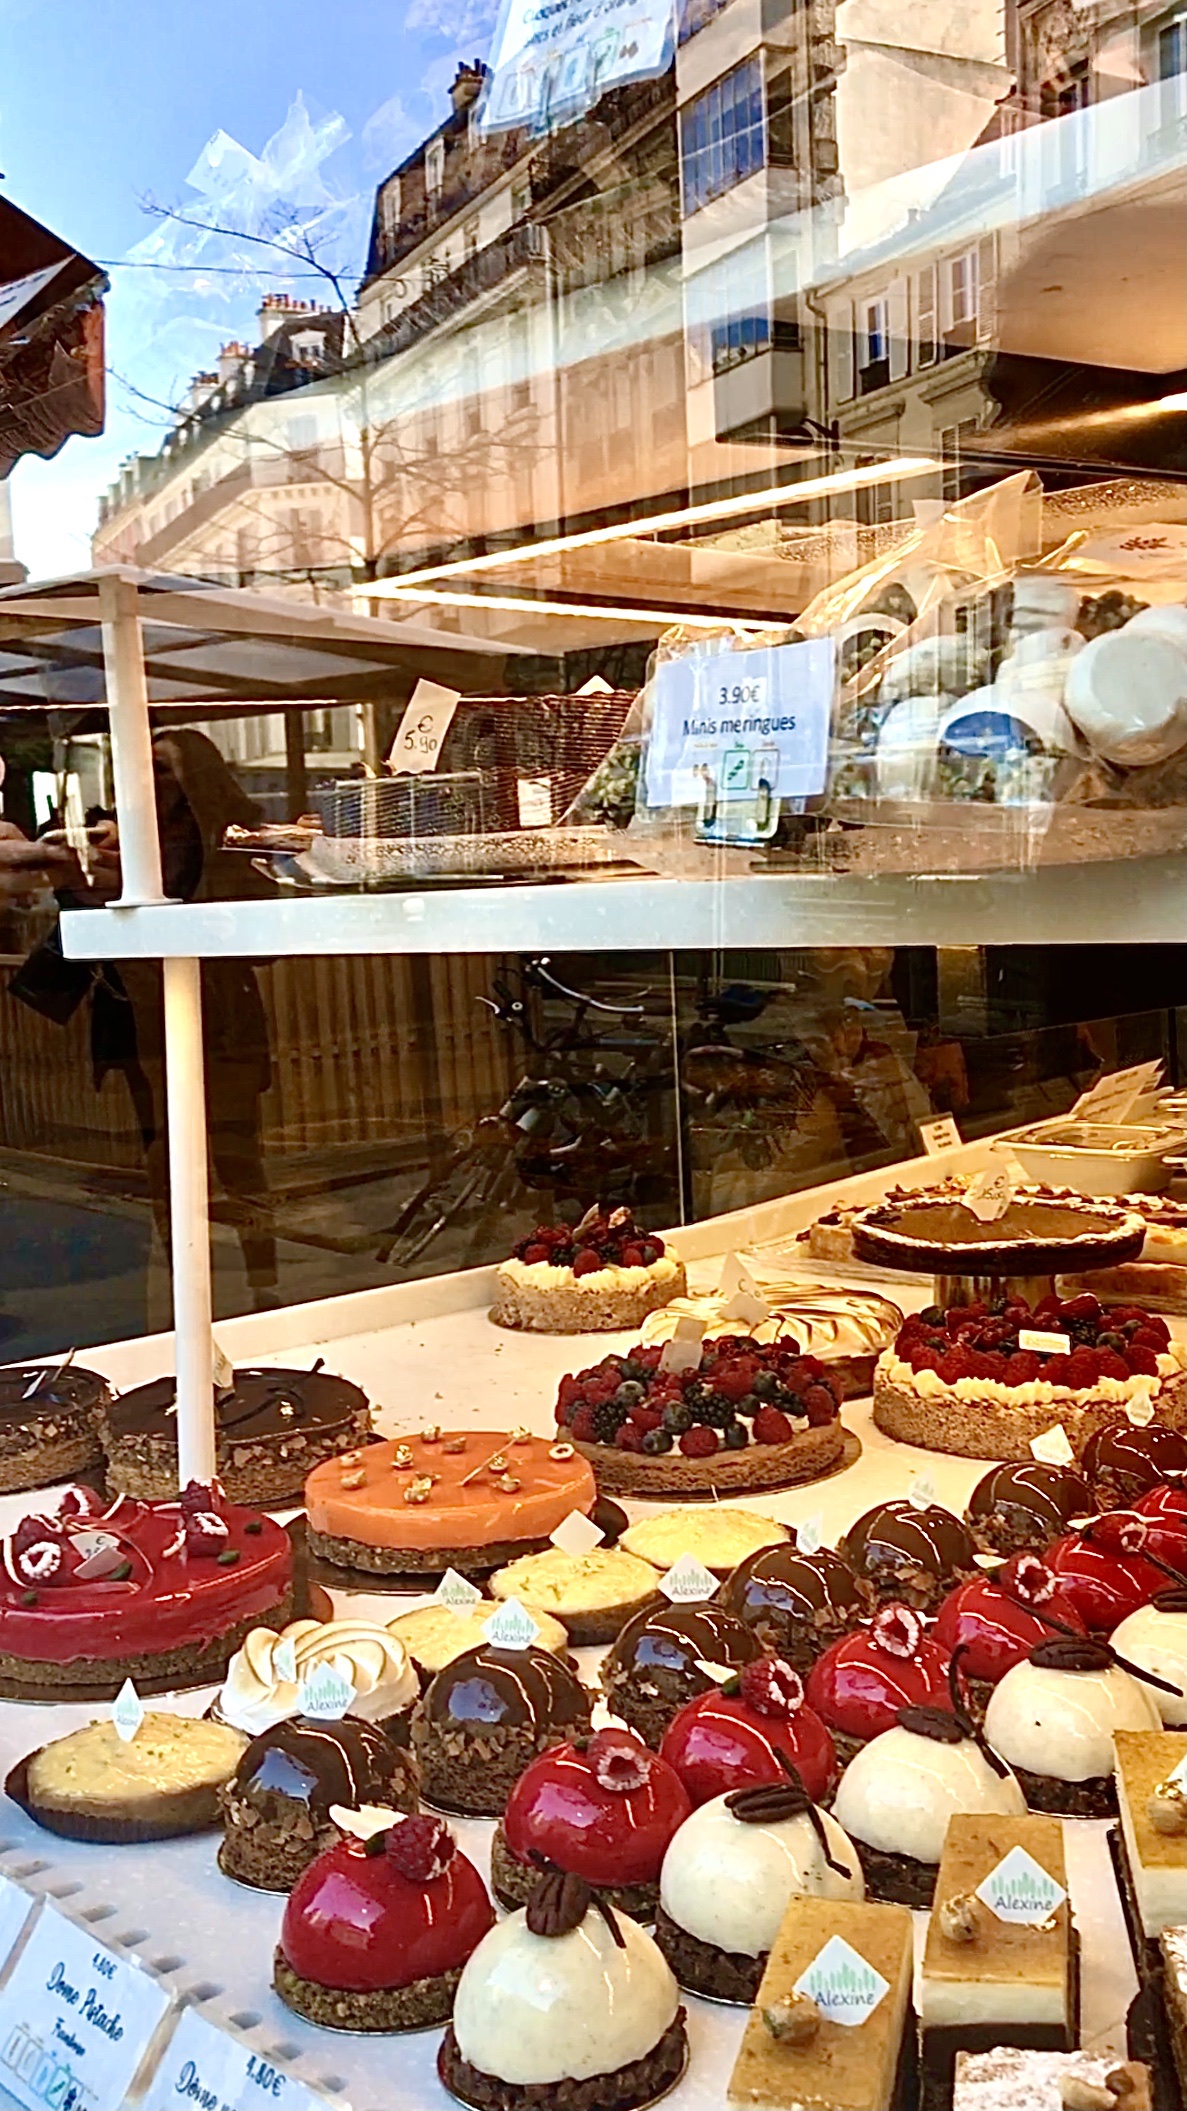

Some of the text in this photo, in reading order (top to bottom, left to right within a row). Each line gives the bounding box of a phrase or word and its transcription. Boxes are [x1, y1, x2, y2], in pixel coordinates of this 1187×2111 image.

[719, 685, 760, 704] 3.90€
[682, 714, 796, 736] Minis meringues
[403, 730, 438, 753] 5.90
[670, 1585, 711, 1596] Alexine
[491, 1629, 532, 1643] Alexine
[306, 1699, 348, 1712] Alexine
[993, 1896, 1053, 1912] Alexine
[815, 1990, 875, 2006] Alexine
